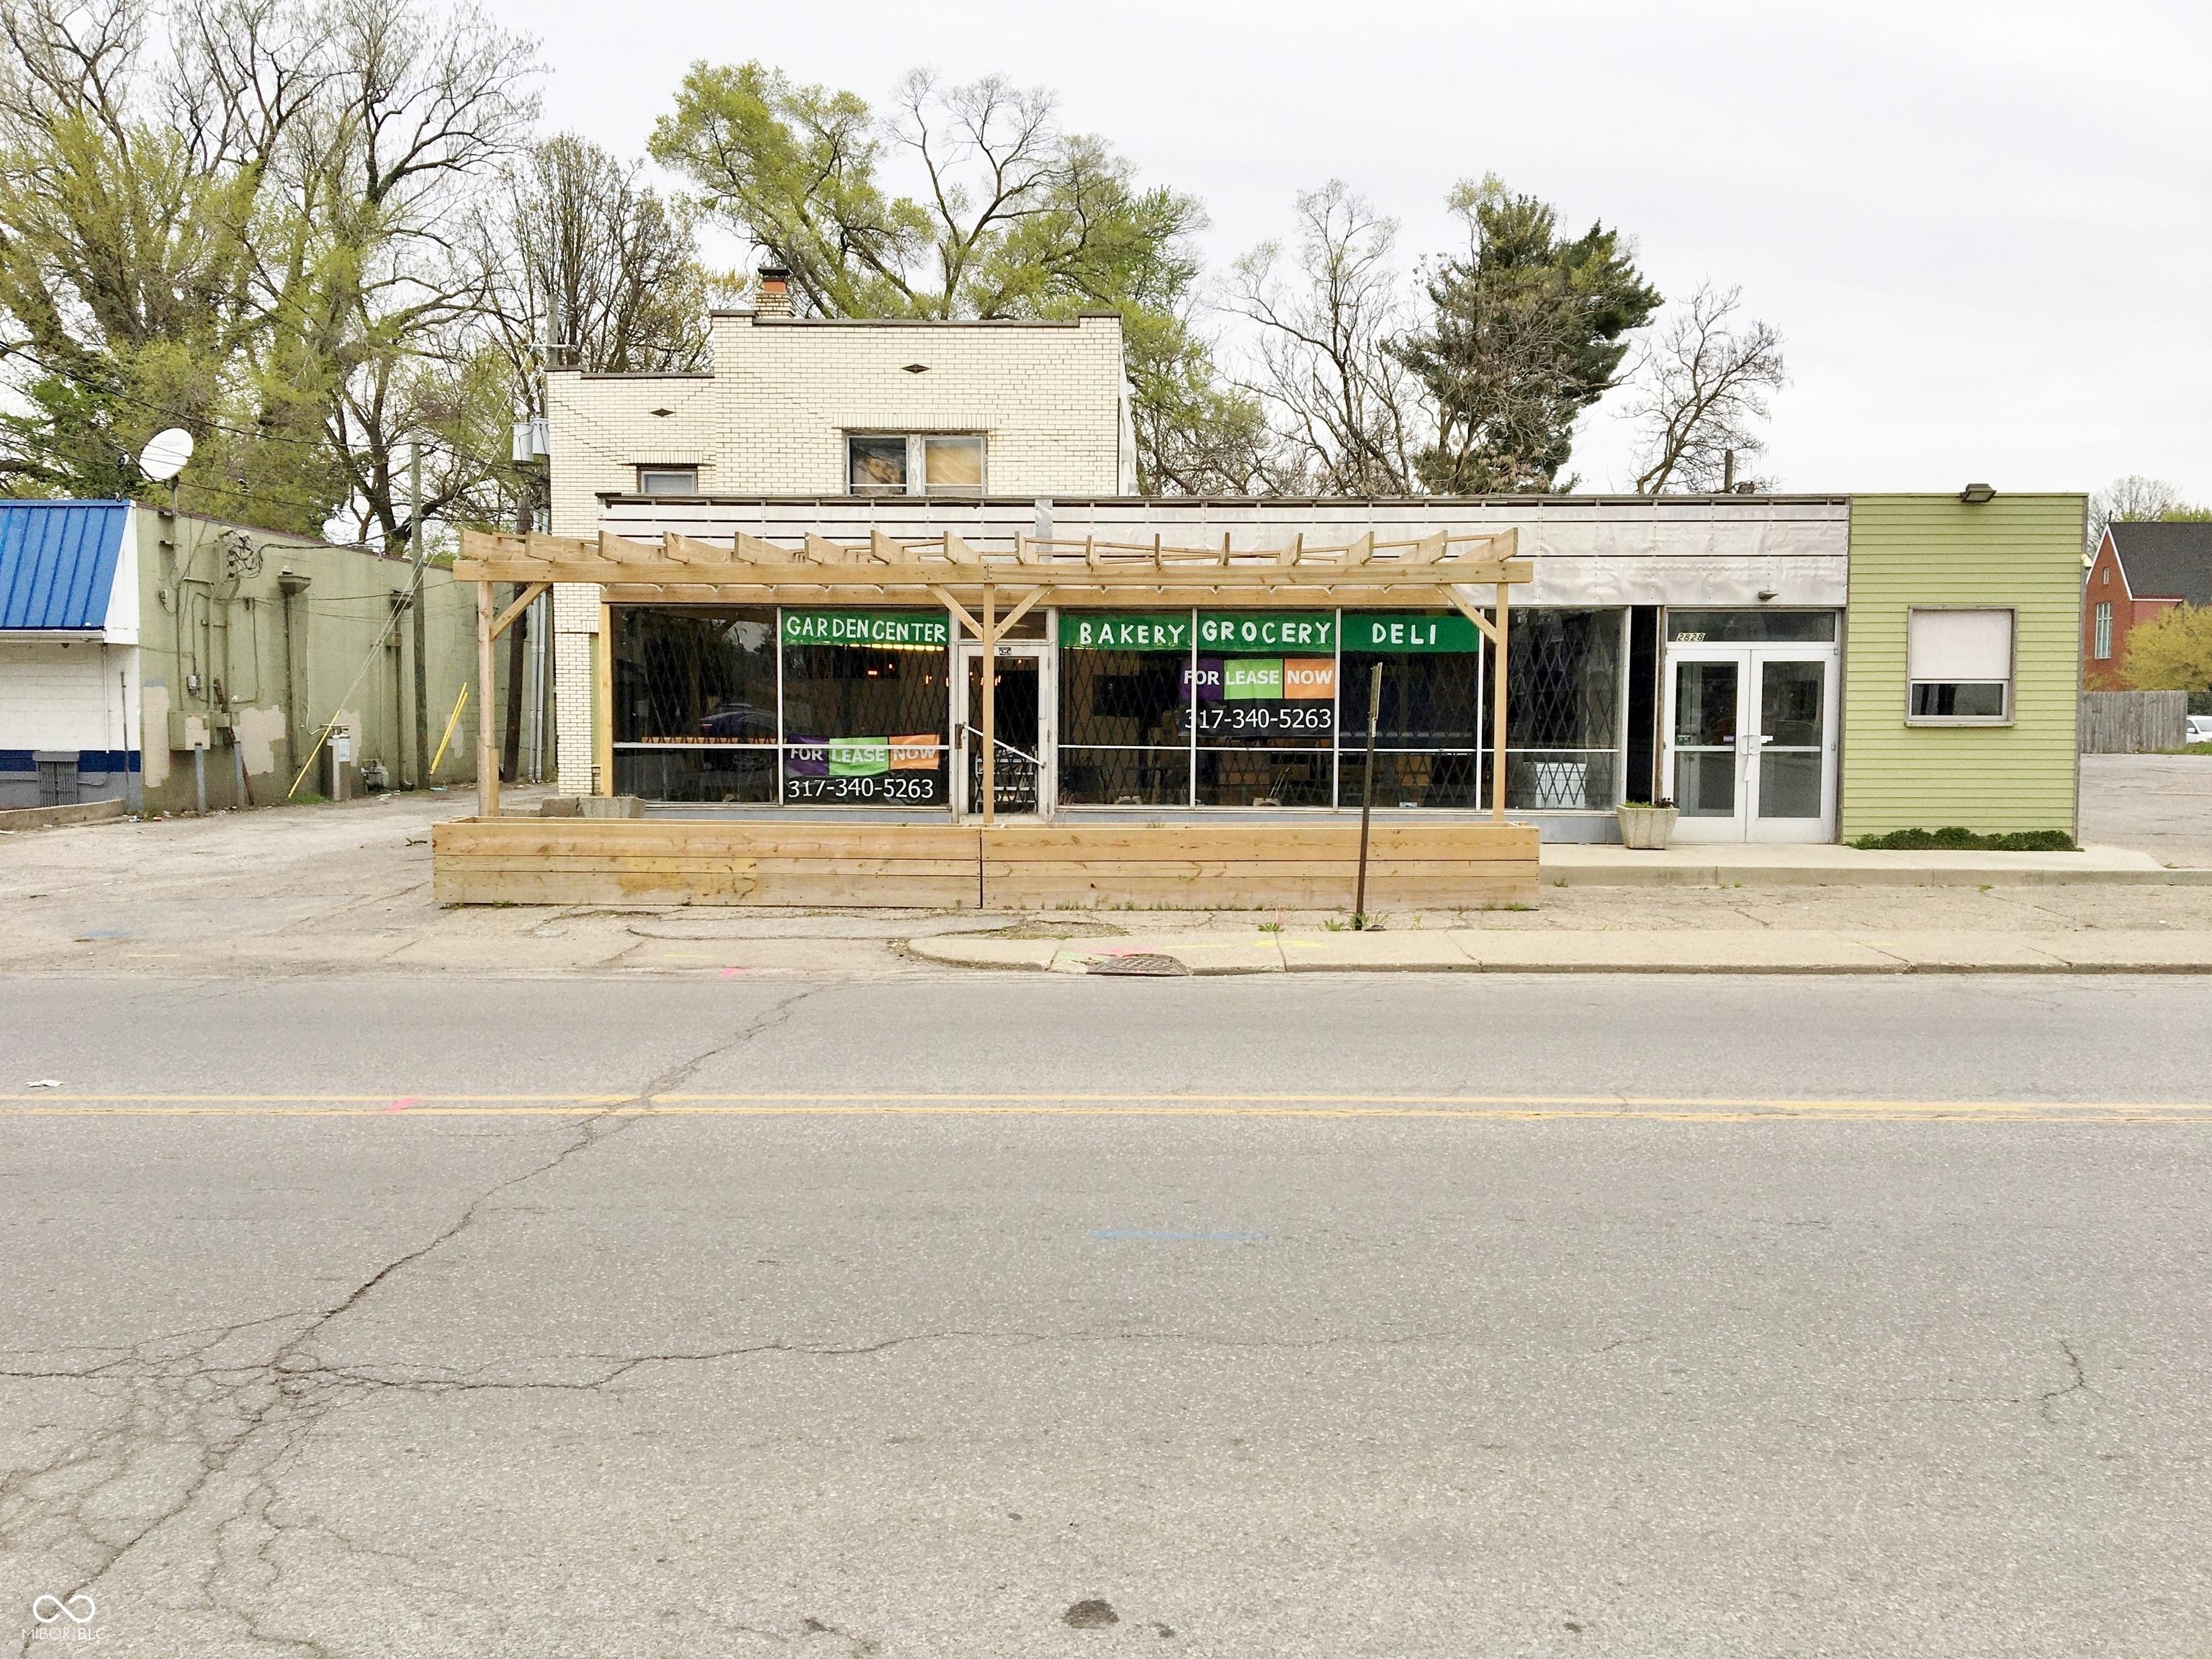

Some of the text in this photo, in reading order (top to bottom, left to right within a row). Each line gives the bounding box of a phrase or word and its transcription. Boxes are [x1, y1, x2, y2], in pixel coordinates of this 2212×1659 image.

[1079, 622, 1185, 644] BAKERY
[1202, 621, 1331, 644] GROCERY
[1372, 623, 1437, 644] DELI
[1184, 670, 1332, 685] FOR LEASE NOW
[791, 747, 936, 763] FOR LEASE NOW
[788, 778, 933, 799] 317-340-5263
